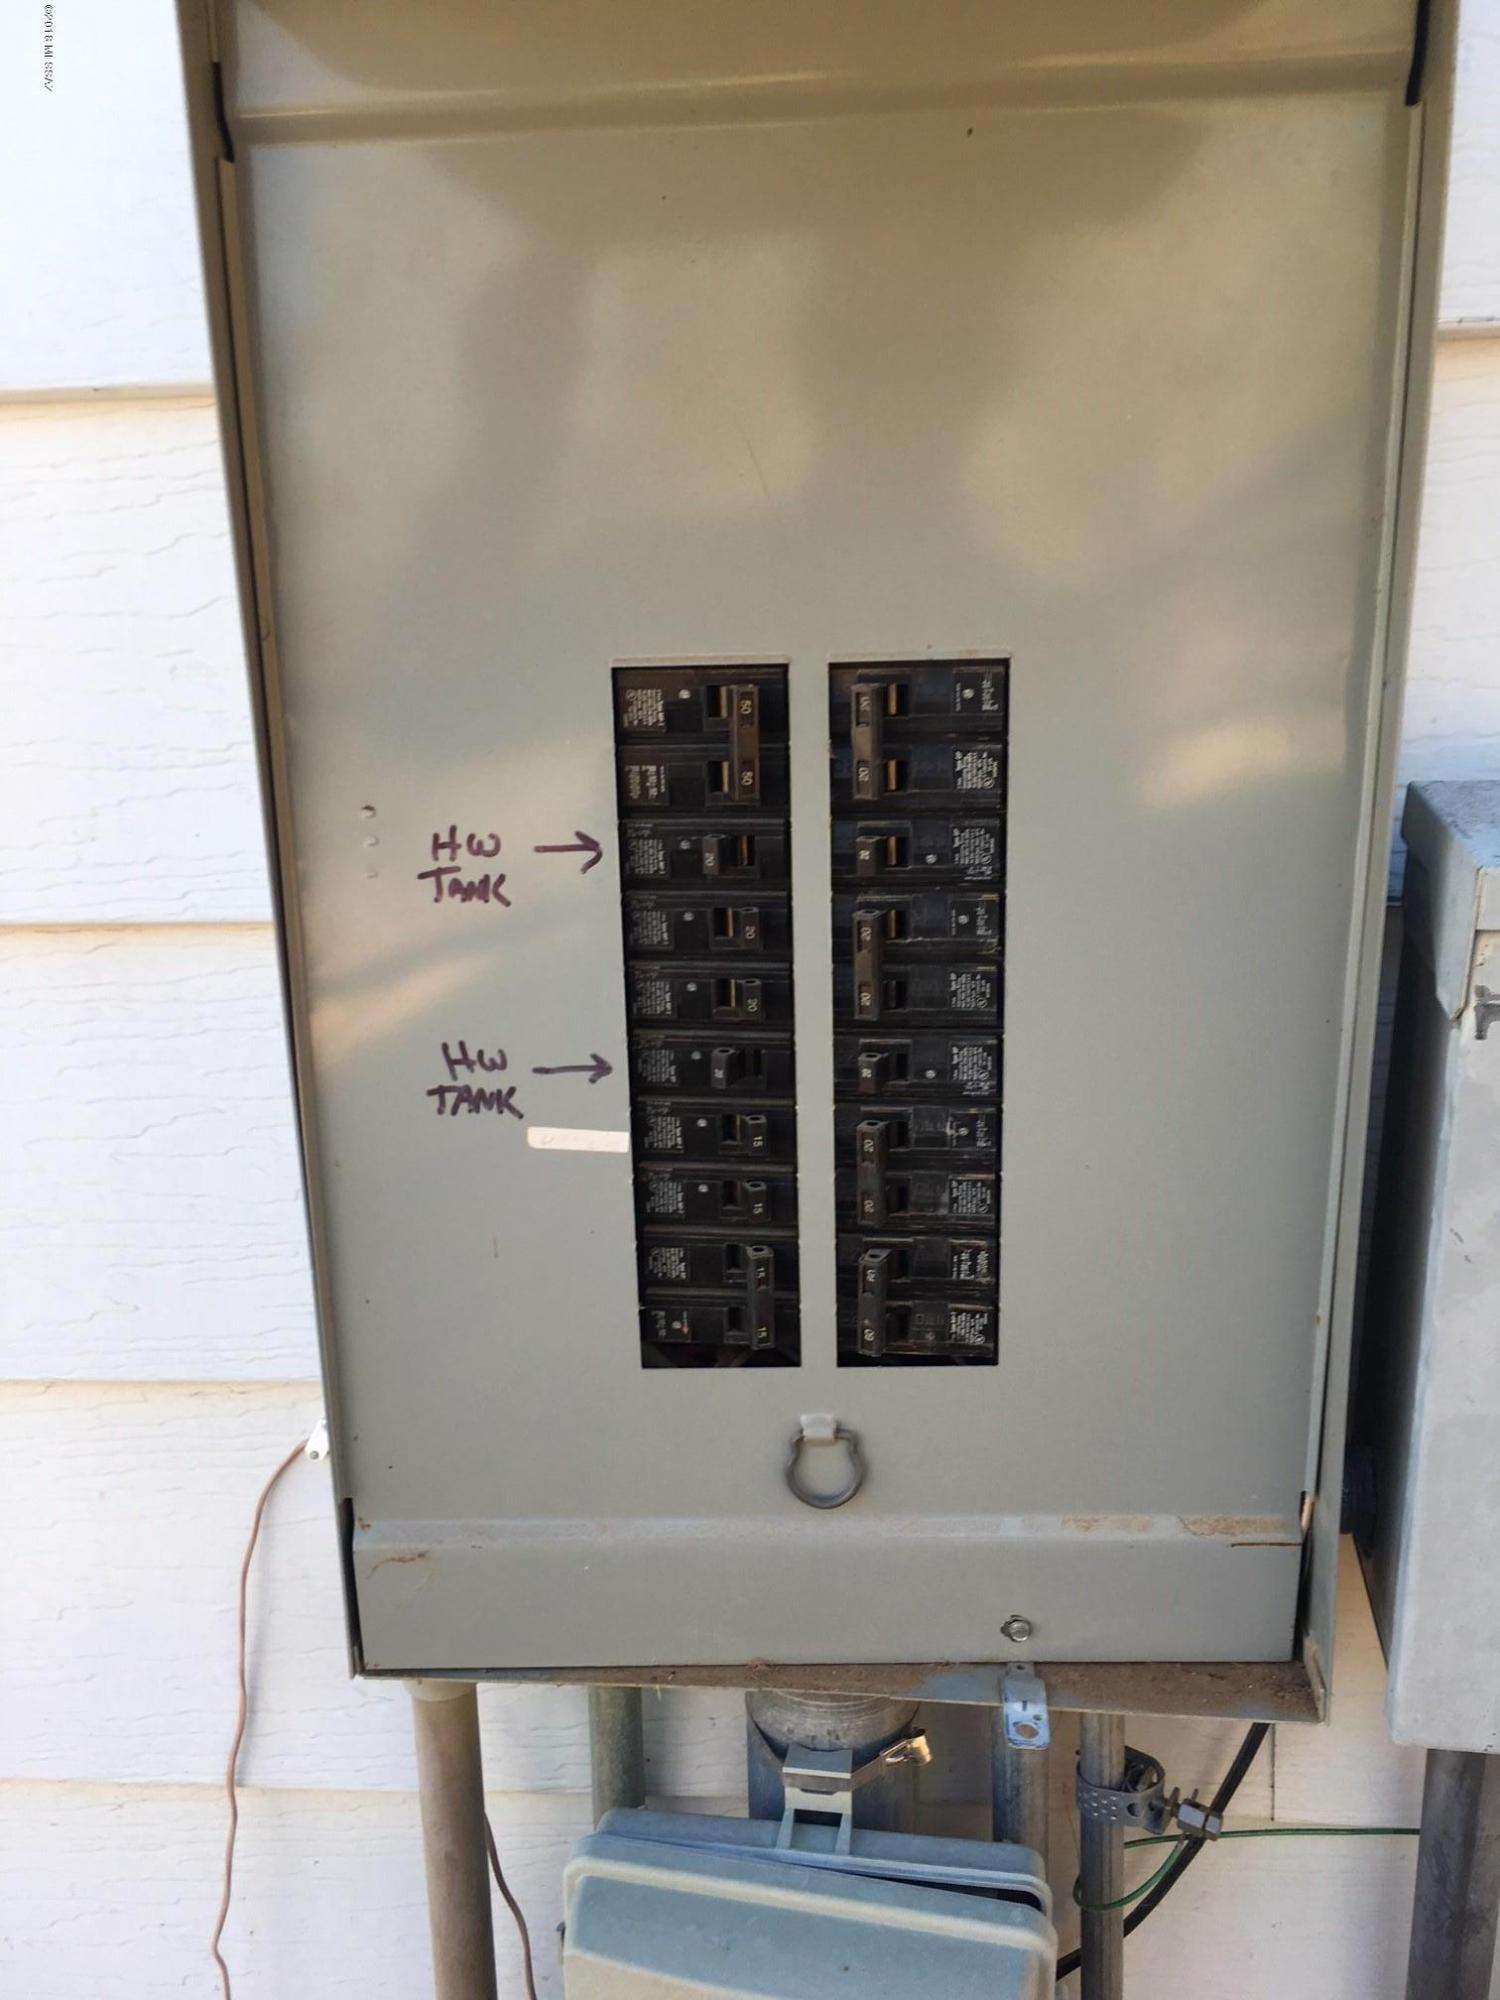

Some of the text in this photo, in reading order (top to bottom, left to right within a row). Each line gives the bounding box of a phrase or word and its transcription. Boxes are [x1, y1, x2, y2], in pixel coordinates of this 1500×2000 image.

[432, 825, 501, 862] HW
[417, 866, 511, 907] TANK
[441, 1040, 508, 1081] HW
[426, 1085, 524, 1119] TANK
